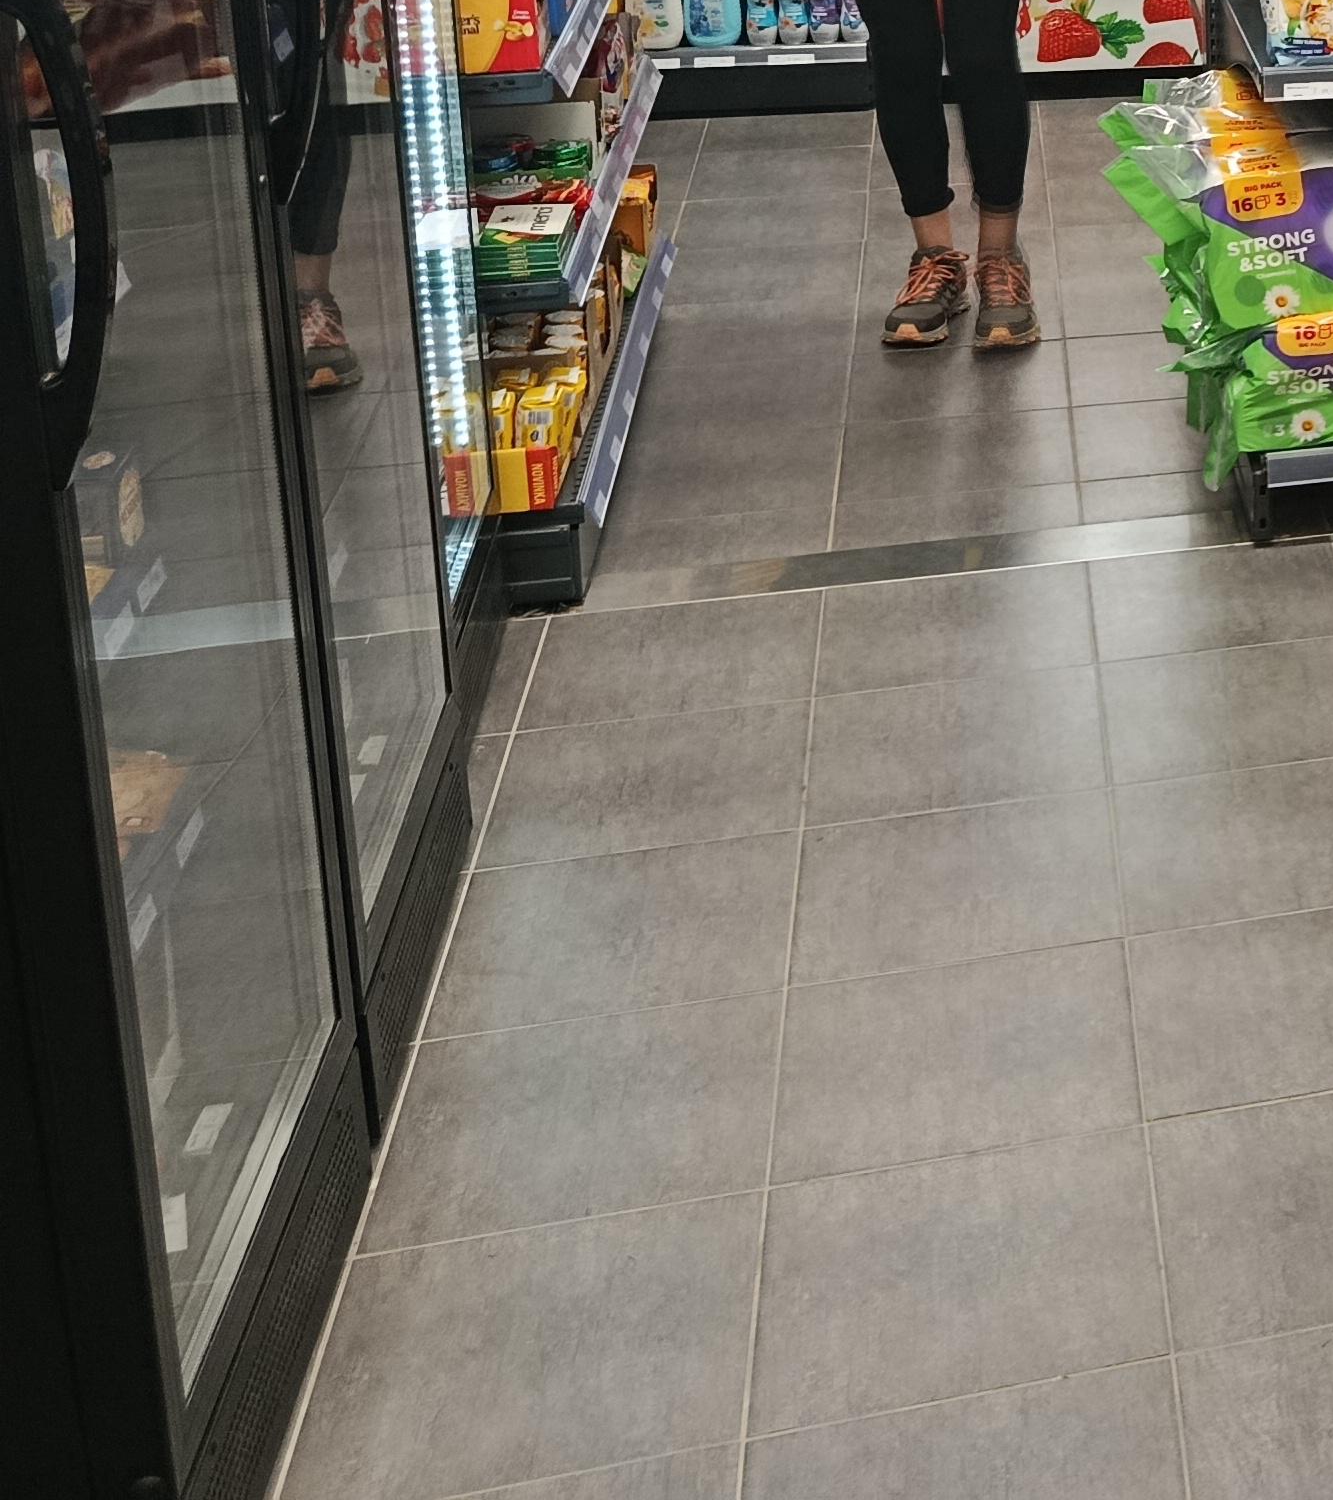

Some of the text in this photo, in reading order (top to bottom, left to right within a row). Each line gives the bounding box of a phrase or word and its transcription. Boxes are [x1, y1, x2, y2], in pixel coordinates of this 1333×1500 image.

[1243, 180, 1283, 193] BIG PACK
[1231, 192, 1287, 214] 16 3
[530, 206, 554, 232] merci
[1227, 228, 1316, 257] STRONG
[1239, 247, 1309, 273] &SOFT
[1293, 325, 1317, 341] 16
[531, 462, 547, 506] NOVINKA
